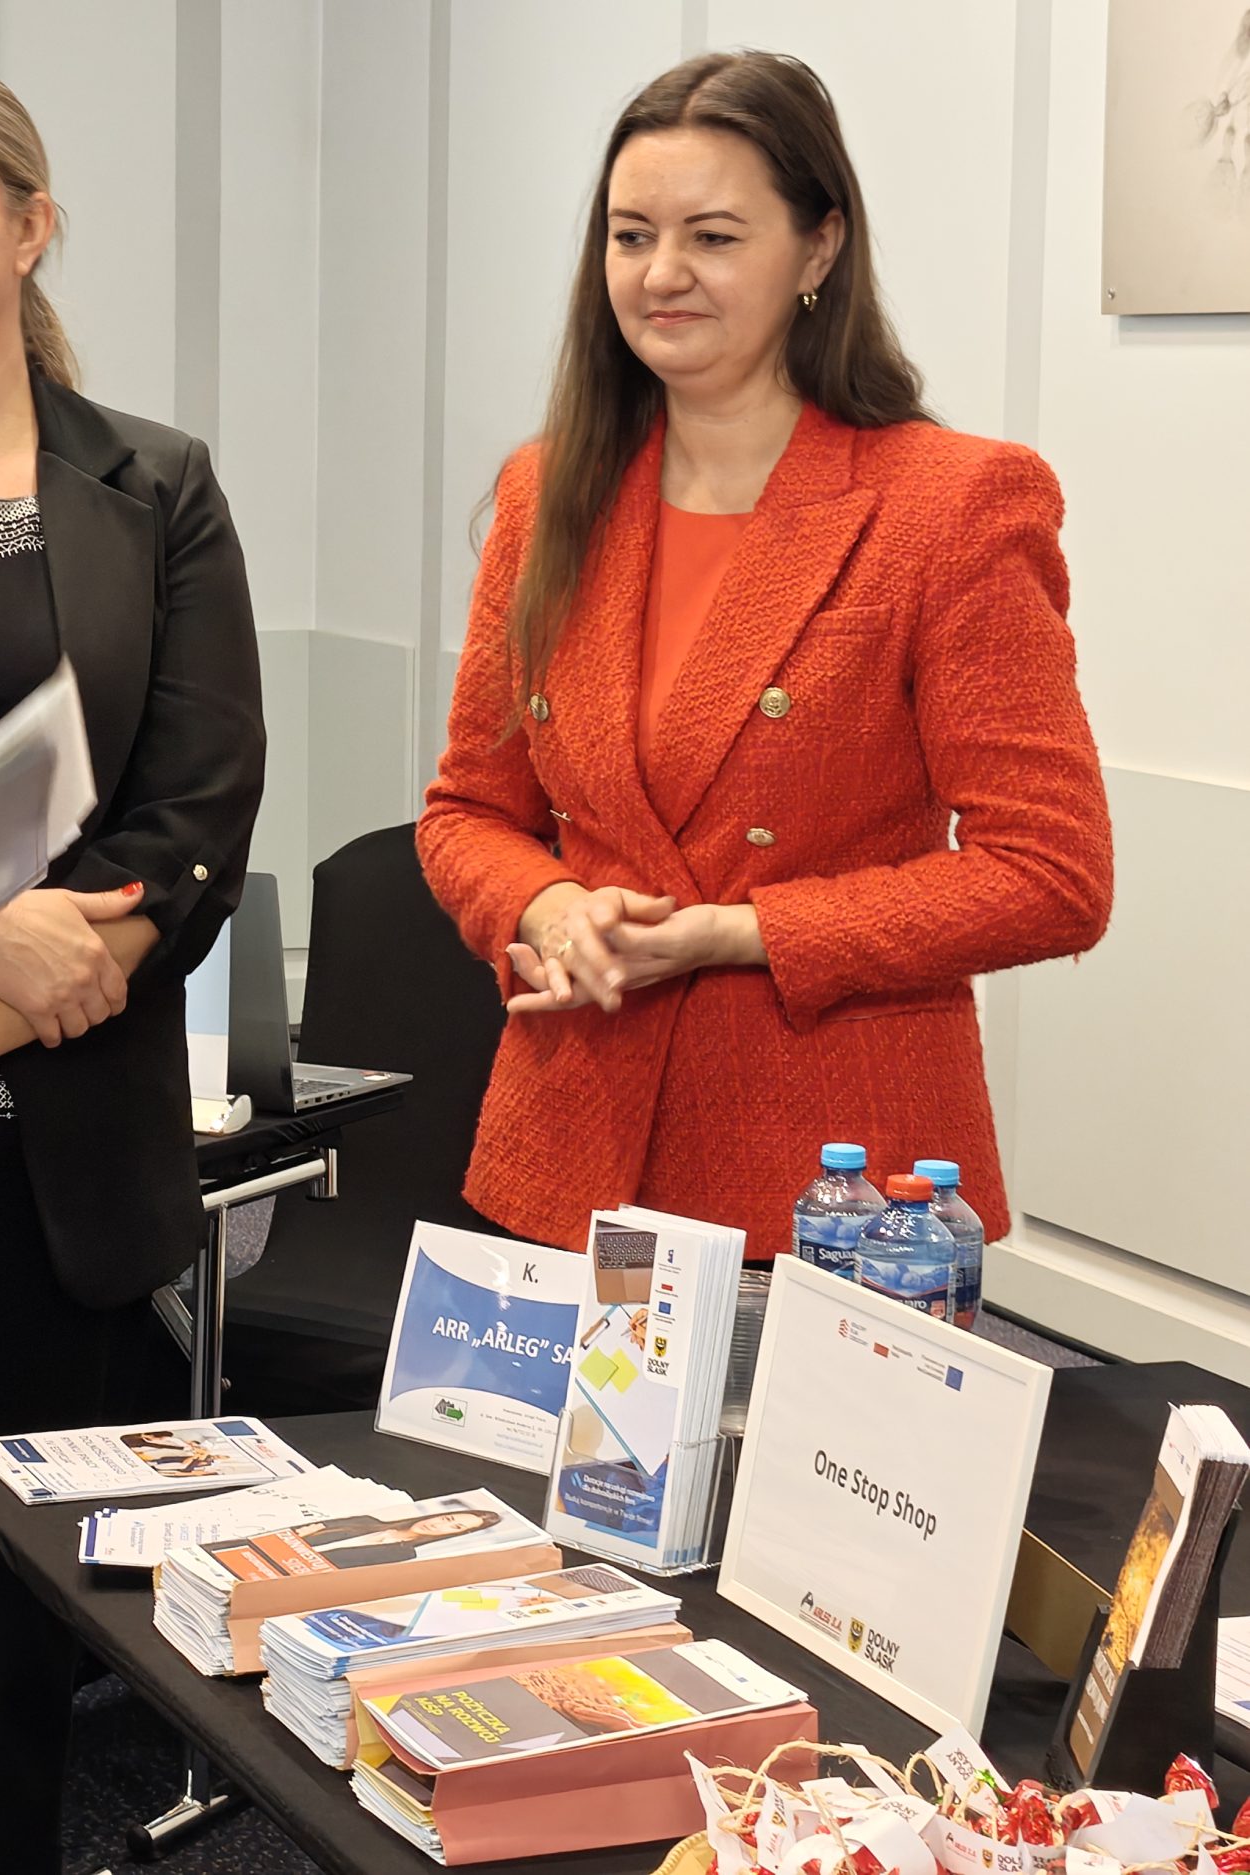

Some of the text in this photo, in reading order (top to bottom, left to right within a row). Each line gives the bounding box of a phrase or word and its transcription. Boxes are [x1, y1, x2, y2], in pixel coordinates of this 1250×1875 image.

[522, 1262, 538, 1284] K.
[818, 1247, 858, 1263] Saguar
[432, 1316, 470, 1341] ARR
[550, 1343, 574, 1365] SA
[814, 1450, 937, 1541] One Stop Shop
[867, 1628, 901, 1659] DOLNY
[432, 1694, 452, 1709] NA
[448, 1706, 501, 1743] ROZWÓJ
[452, 1690, 511, 1735] POŻYCZKA
